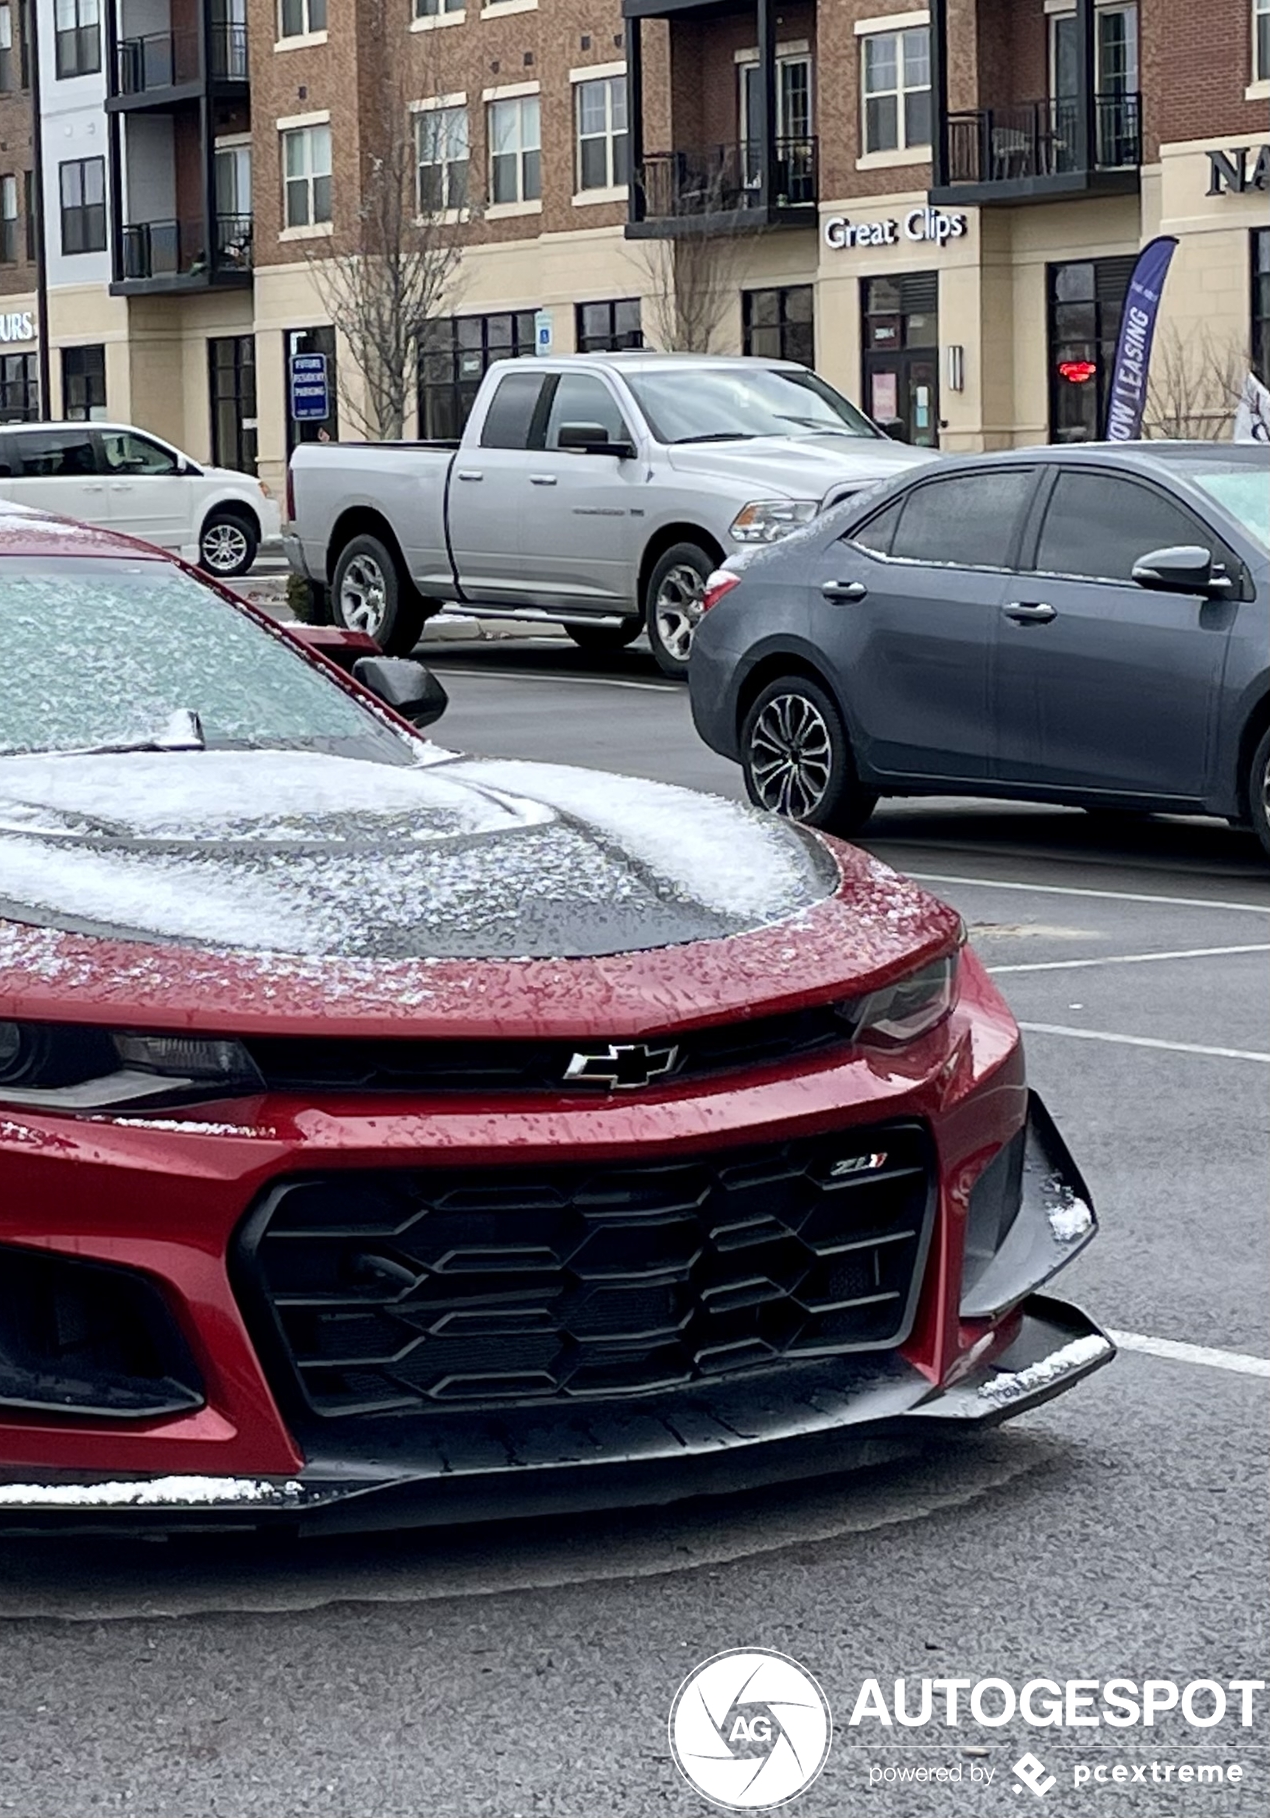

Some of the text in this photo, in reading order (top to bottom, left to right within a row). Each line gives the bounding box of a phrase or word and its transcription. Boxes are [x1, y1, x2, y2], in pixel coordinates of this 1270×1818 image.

[824, 207, 967, 249] Great Clips
[1114, 306, 1149, 400] LEASING
[1109, 399, 1136, 441] OW
[830, 1151, 888, 1176] ZL1
